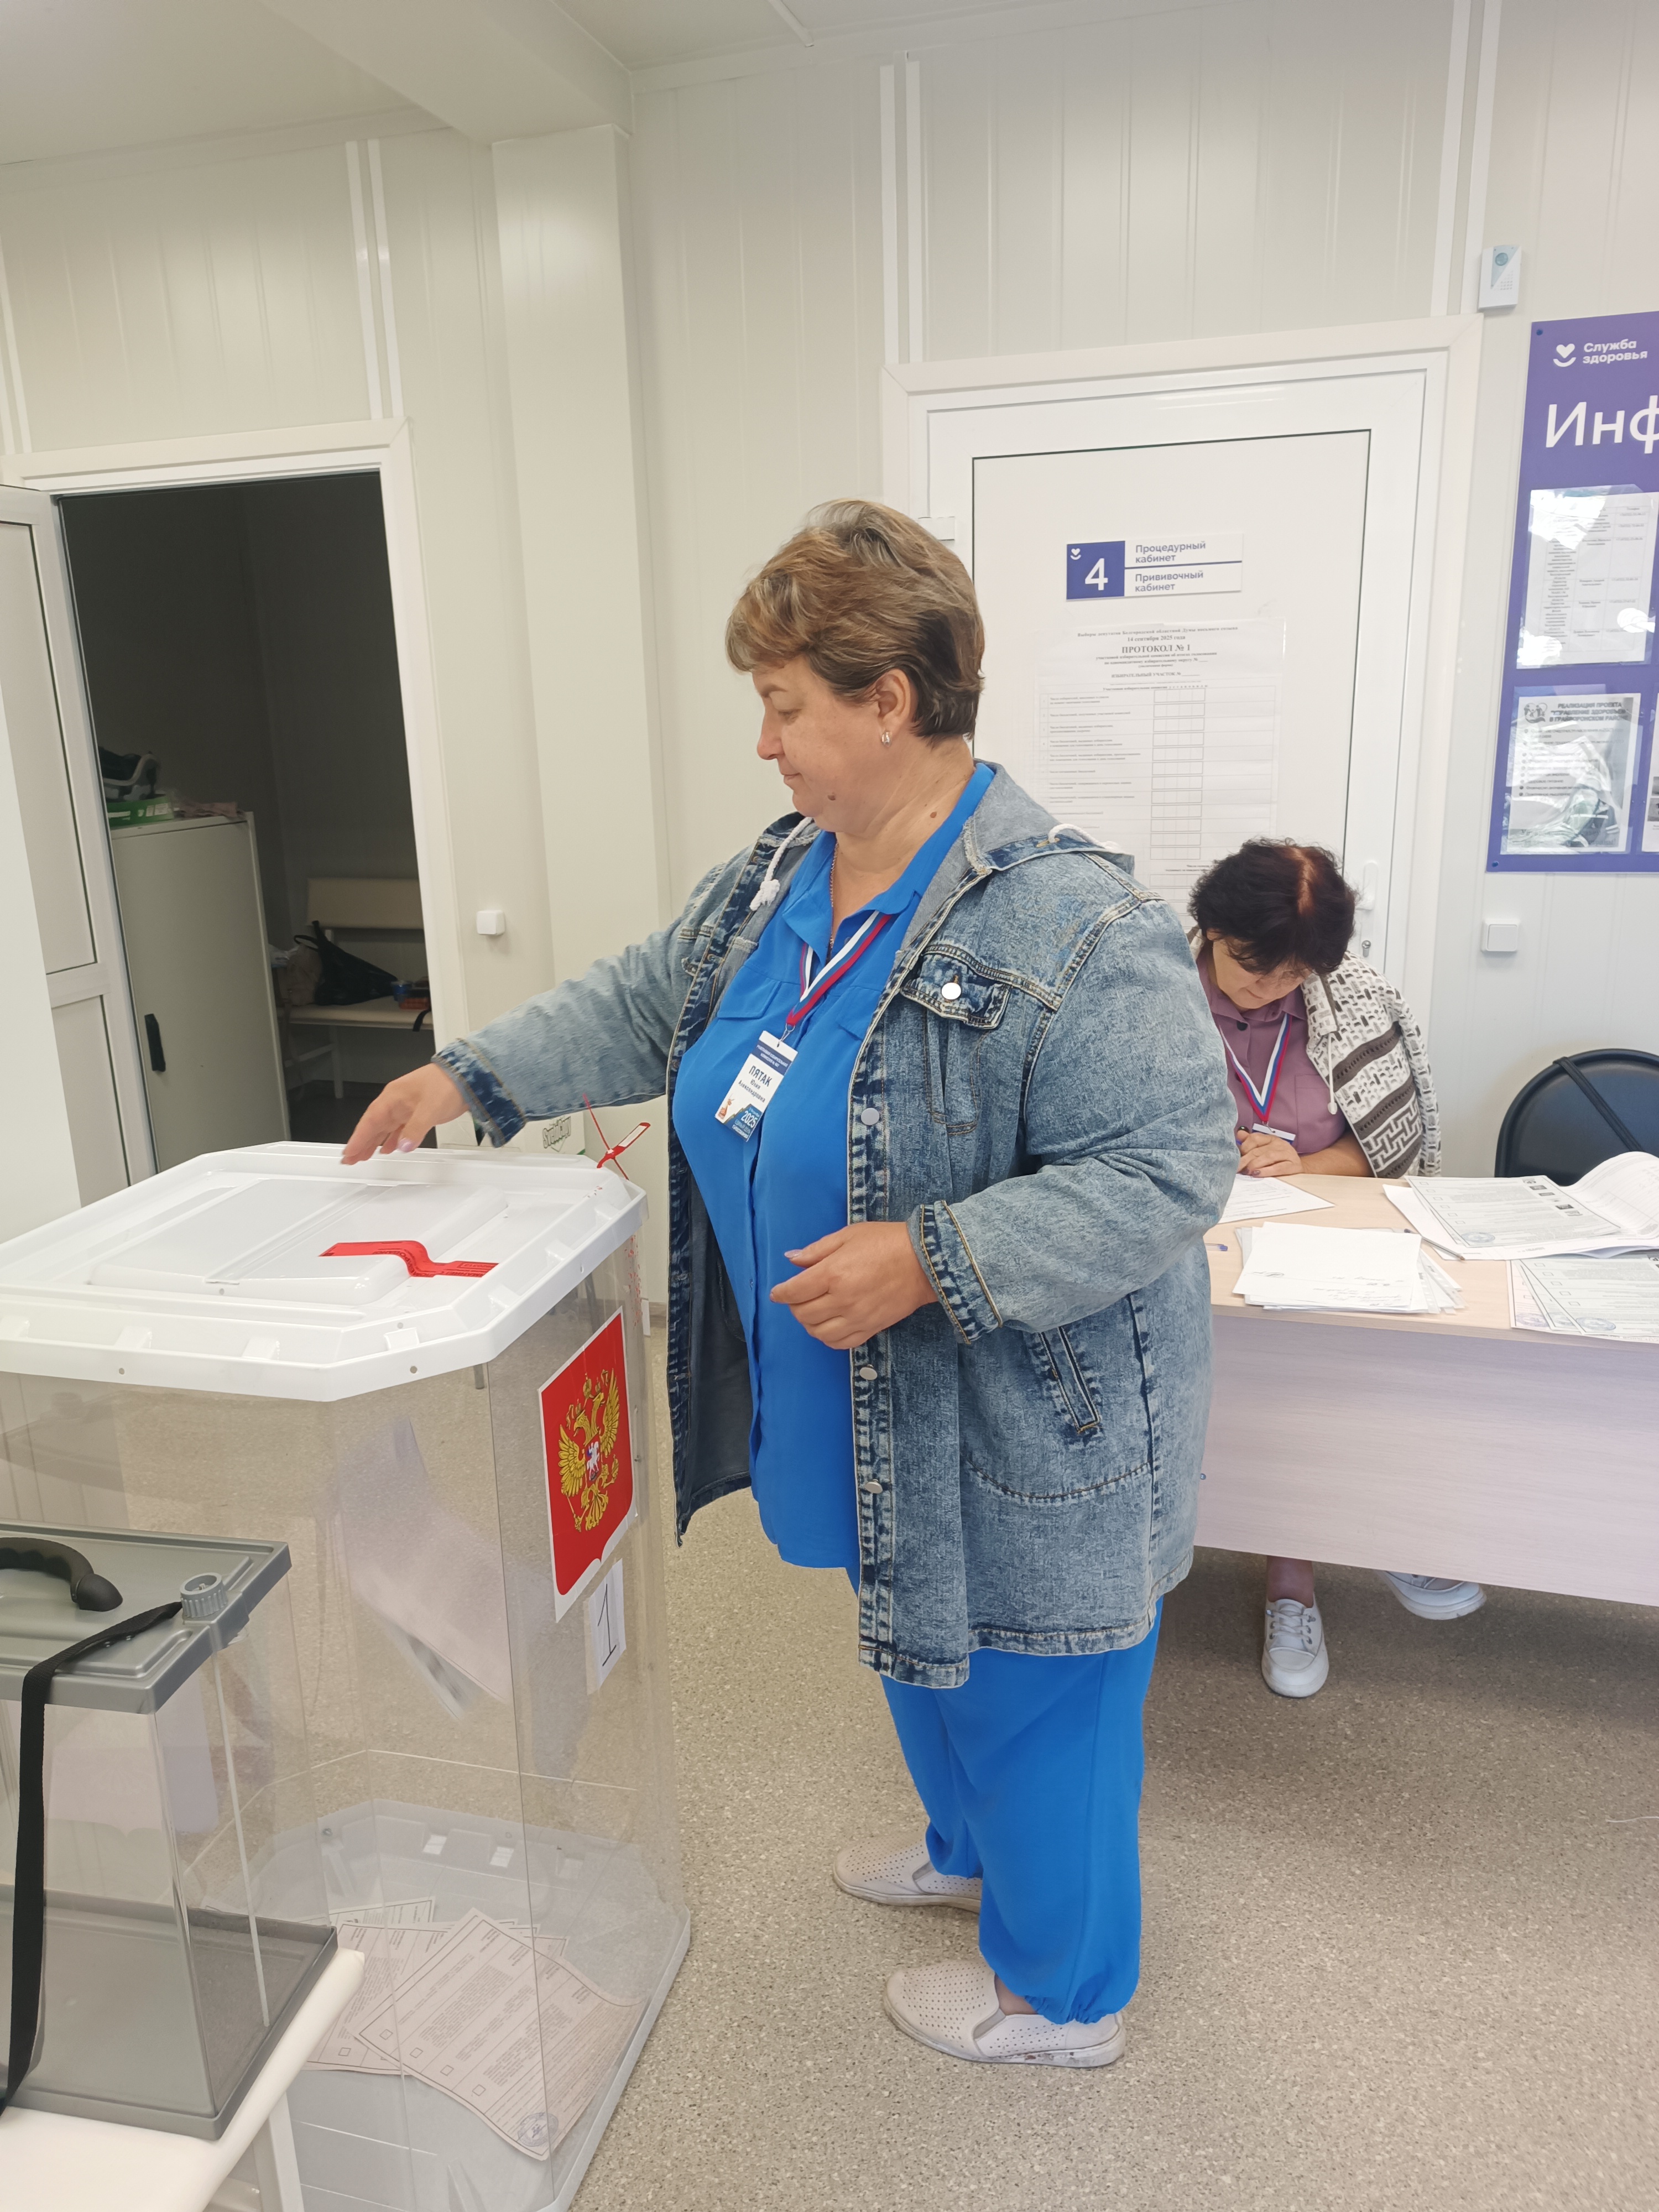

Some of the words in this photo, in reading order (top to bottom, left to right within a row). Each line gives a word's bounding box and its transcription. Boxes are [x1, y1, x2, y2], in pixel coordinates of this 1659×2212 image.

[1584, 338, 1637, 353] Служба
[1583, 351, 1648, 364] здоровья
[1135, 541, 1206, 554] Процедурный
[1135, 555, 1176, 563] кабинет
[1085, 558, 1108, 591] 4
[1135, 570, 1203, 583] Прививочный
[1135, 583, 1175, 592] кабинет
[1121, 645, 1172, 653] ПРОТОКОЛ
[749, 1065, 772, 1087] ПЯТАК
[738, 1079, 766, 1103] Александровна
[750, 1079, 761, 1090] Юлия
[741, 1110, 758, 1128] 2025
[598, 1583, 617, 1667] 1
